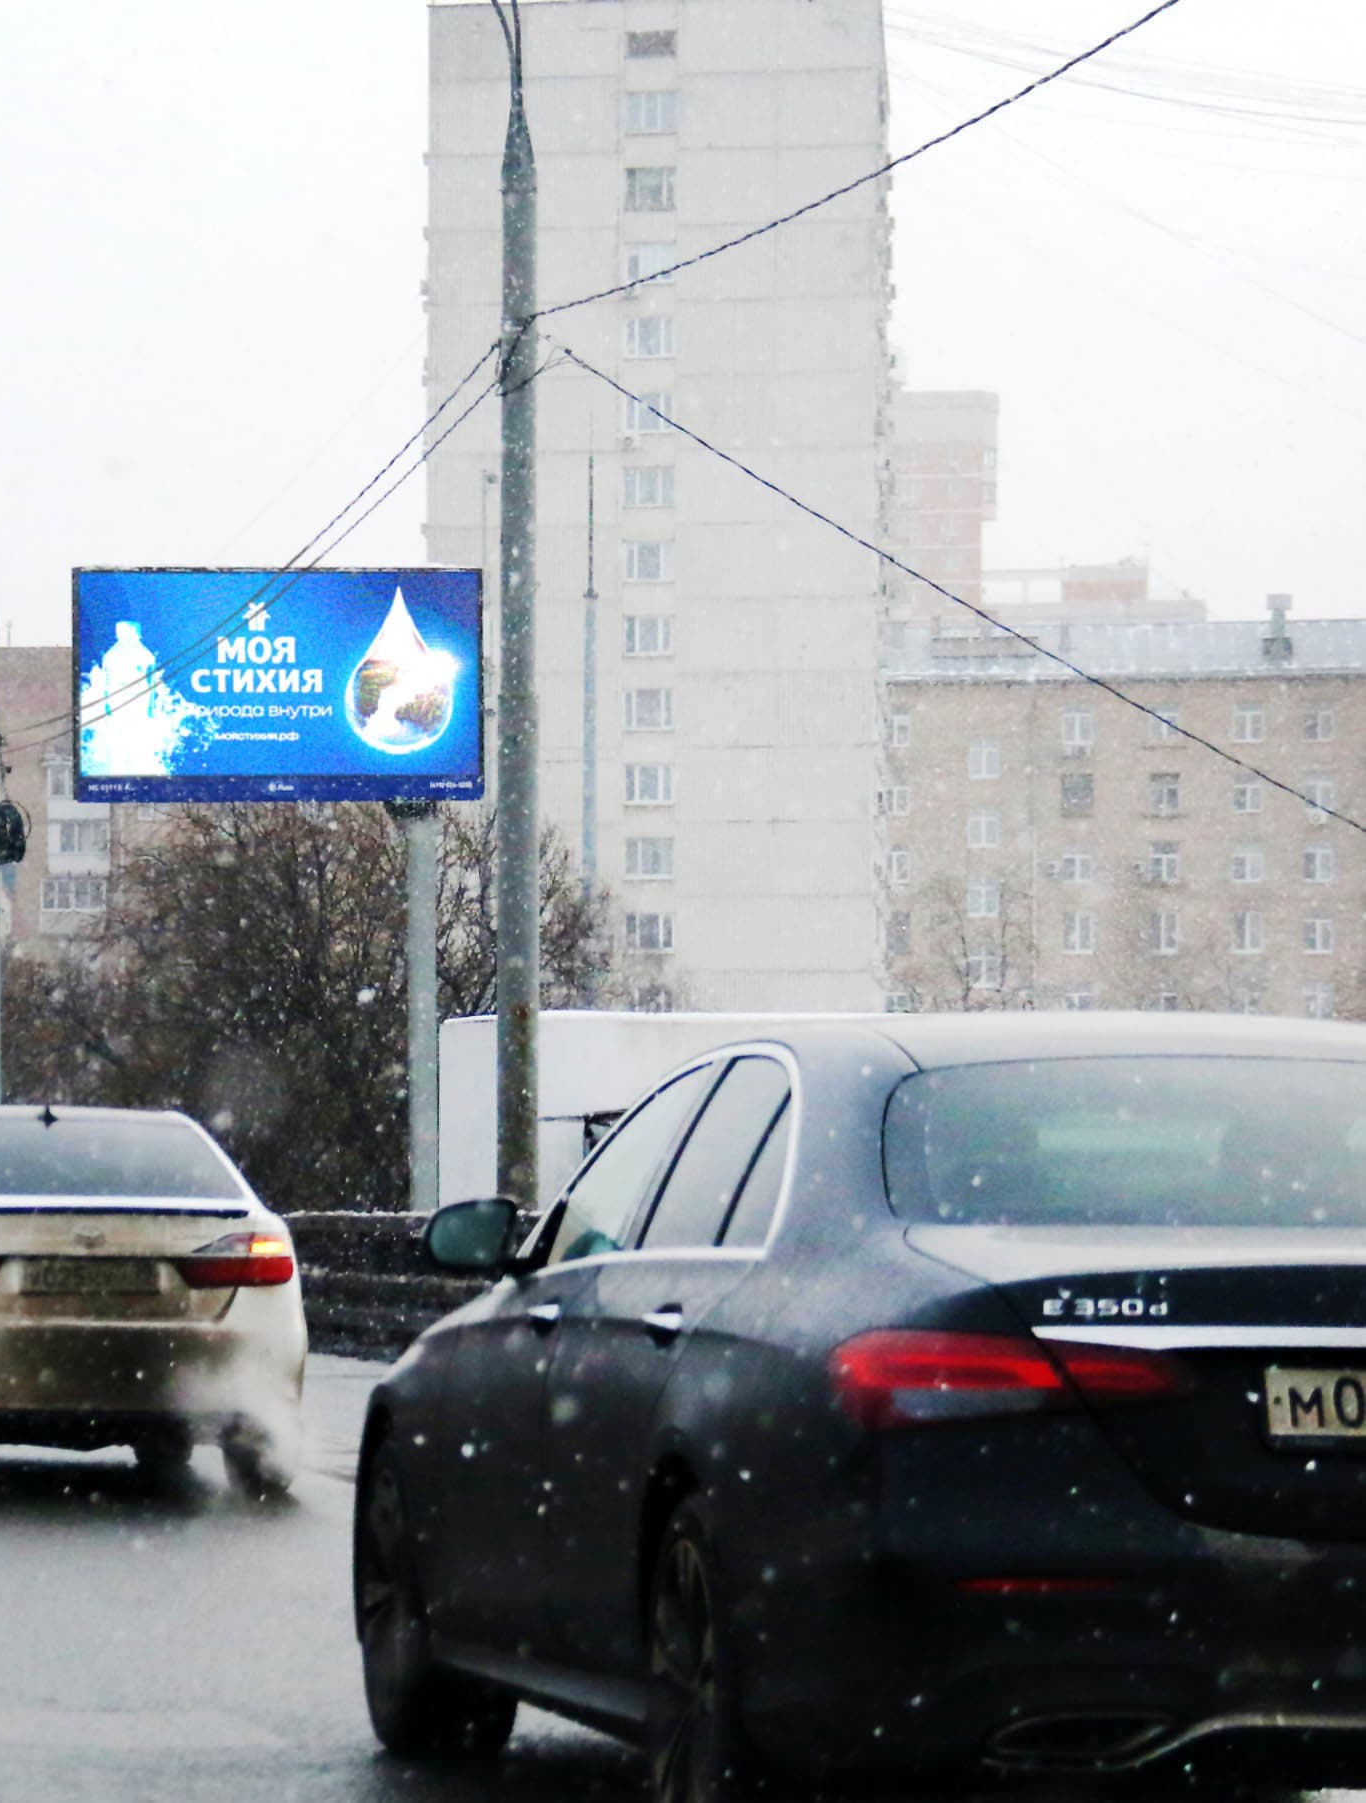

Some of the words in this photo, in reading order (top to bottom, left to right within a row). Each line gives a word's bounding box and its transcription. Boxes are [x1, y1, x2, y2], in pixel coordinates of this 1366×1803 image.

[217, 636, 296, 664] МОЯ
[190, 668, 323, 693] СТИХИЯ
[268, 705, 333, 719] внутри
[1043, 1299, 1064, 1316] E
